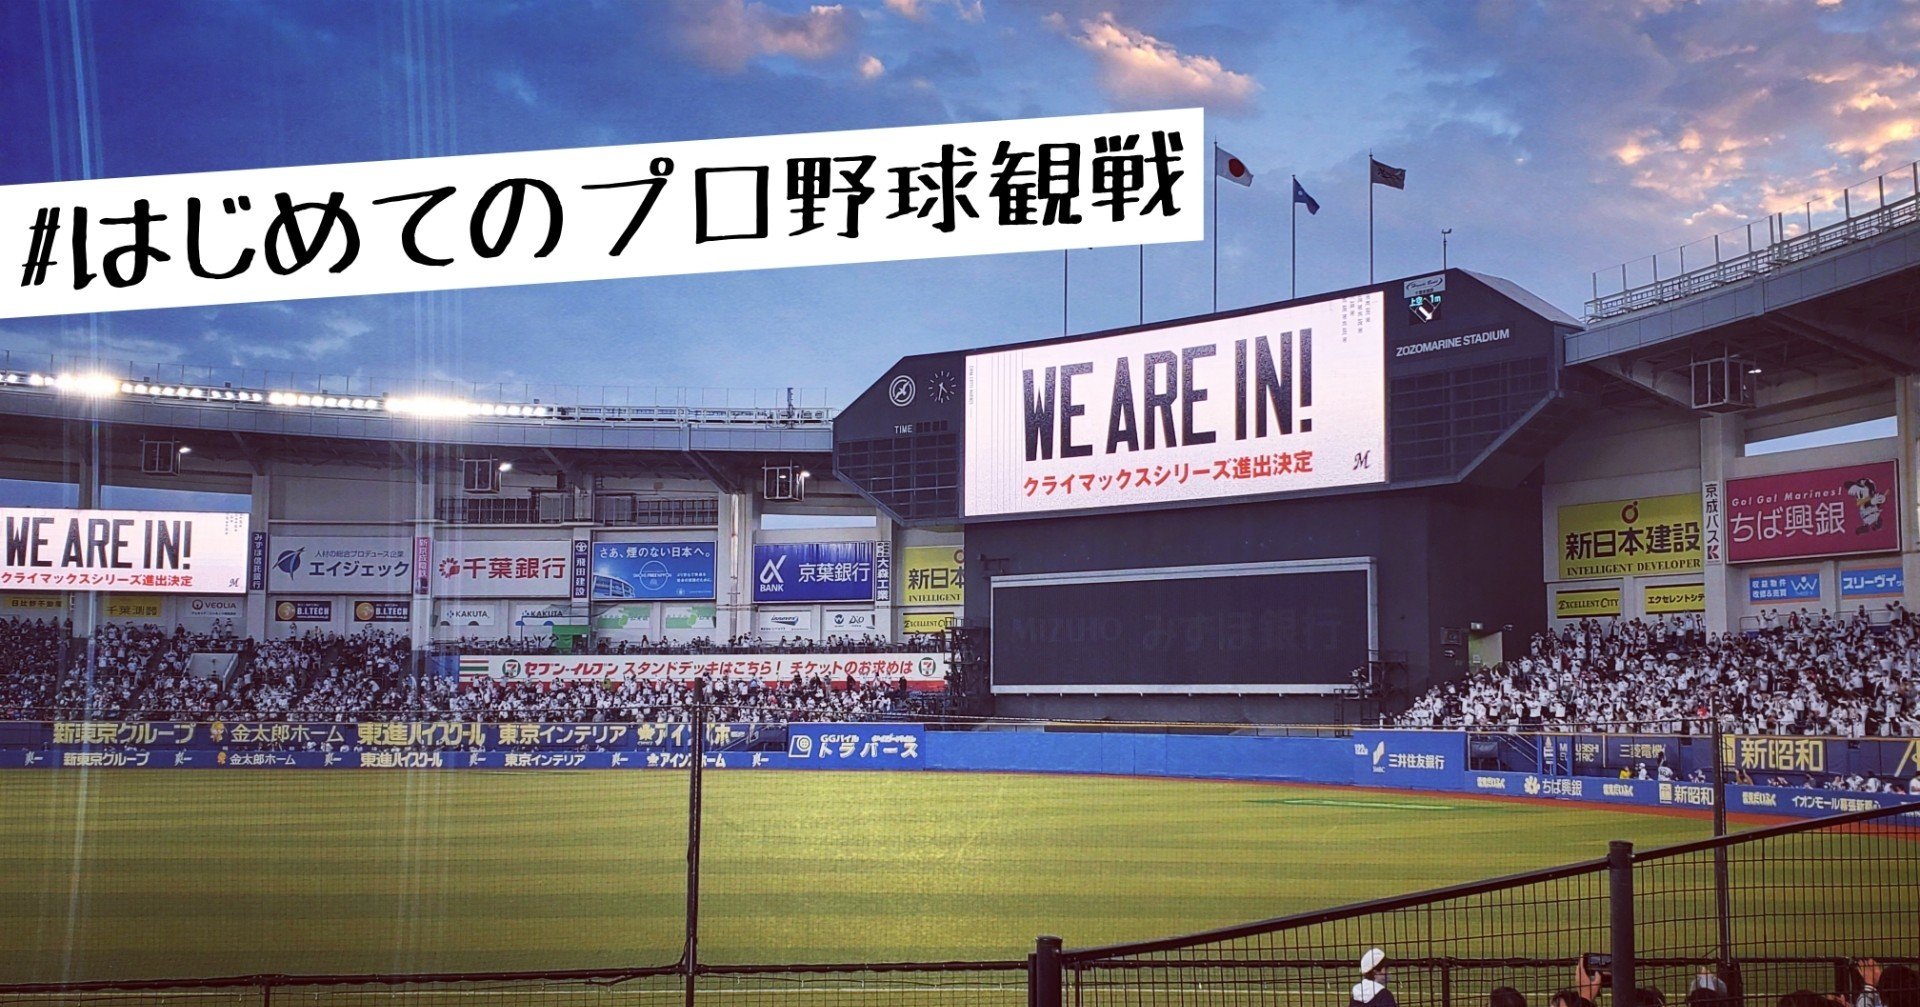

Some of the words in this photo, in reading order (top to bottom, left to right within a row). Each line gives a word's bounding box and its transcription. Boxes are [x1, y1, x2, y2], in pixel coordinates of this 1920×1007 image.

[1396, 337, 1461, 357] ZOZOMARINE
[1463, 328, 1510, 346] STADIUM
[1023, 362, 1093, 462] WE
[1105, 343, 1217, 455] ARE
[1235, 328, 1312, 441] IN!
[894, 425, 913, 434] TIME
[1023, 450, 1313, 497] クライマックスシリーズ進出決定
[1732, 497, 1752, 507] Go!
[1757, 494, 1778, 505] Go!
[1784, 486, 1843, 501] Marines!
[1704, 483, 1719, 543] 京成バス
[1730, 502, 1846, 543] ちば興銀
[6, 516, 54, 567] WE
[61, 517, 135, 569] ARE
[143, 519, 192, 570] IN!
[1565, 521, 1700, 561] 新日本建設
[252, 534, 263, 590] みずほ信託銀行
[314, 550, 405, 558] 人材の総合プロデュース企業
[600, 546, 711, 559] さあ、煙のない日本へ。
[309, 561, 409, 578] エイジェック
[463, 557, 566, 579] 千葉銀行
[575, 557, 587, 596] 飛田建設
[798, 562, 871, 583] 京葉銀行
[1567, 563, 1633, 576] INTELLIGENT
[1637, 558, 1701, 571] DEVELOPER
[1, 571, 193, 587] クライマックスシリーズ進出決定
[760, 583, 784, 592] BANK
[877, 557, 889, 600] 大森工業
[908, 593, 961, 602] INTELLIGENT
[790, 660, 914, 675] チケットのお求めは
[53, 721, 197, 744] 新東京グループ
[231, 723, 344, 743] 金太郎ホーム
[357, 721, 486, 746] 東進ハイスクール
[497, 723, 627, 745] 東京インテリア
[64, 752, 150, 767] 新東京グループ
[229, 753, 296, 766] 金太郎ホーム
[360, 752, 442, 768] 東進ハイスクール
[504, 753, 586, 767] 東京インテリア
[819, 742, 918, 758] トラバース
[1740, 738, 1824, 772] 新昭和
[1388, 753, 1445, 769] 三井住友銀行
[1542, 779, 1582, 796] ちば興銀
[1674, 787, 1714, 806] 新昭和
